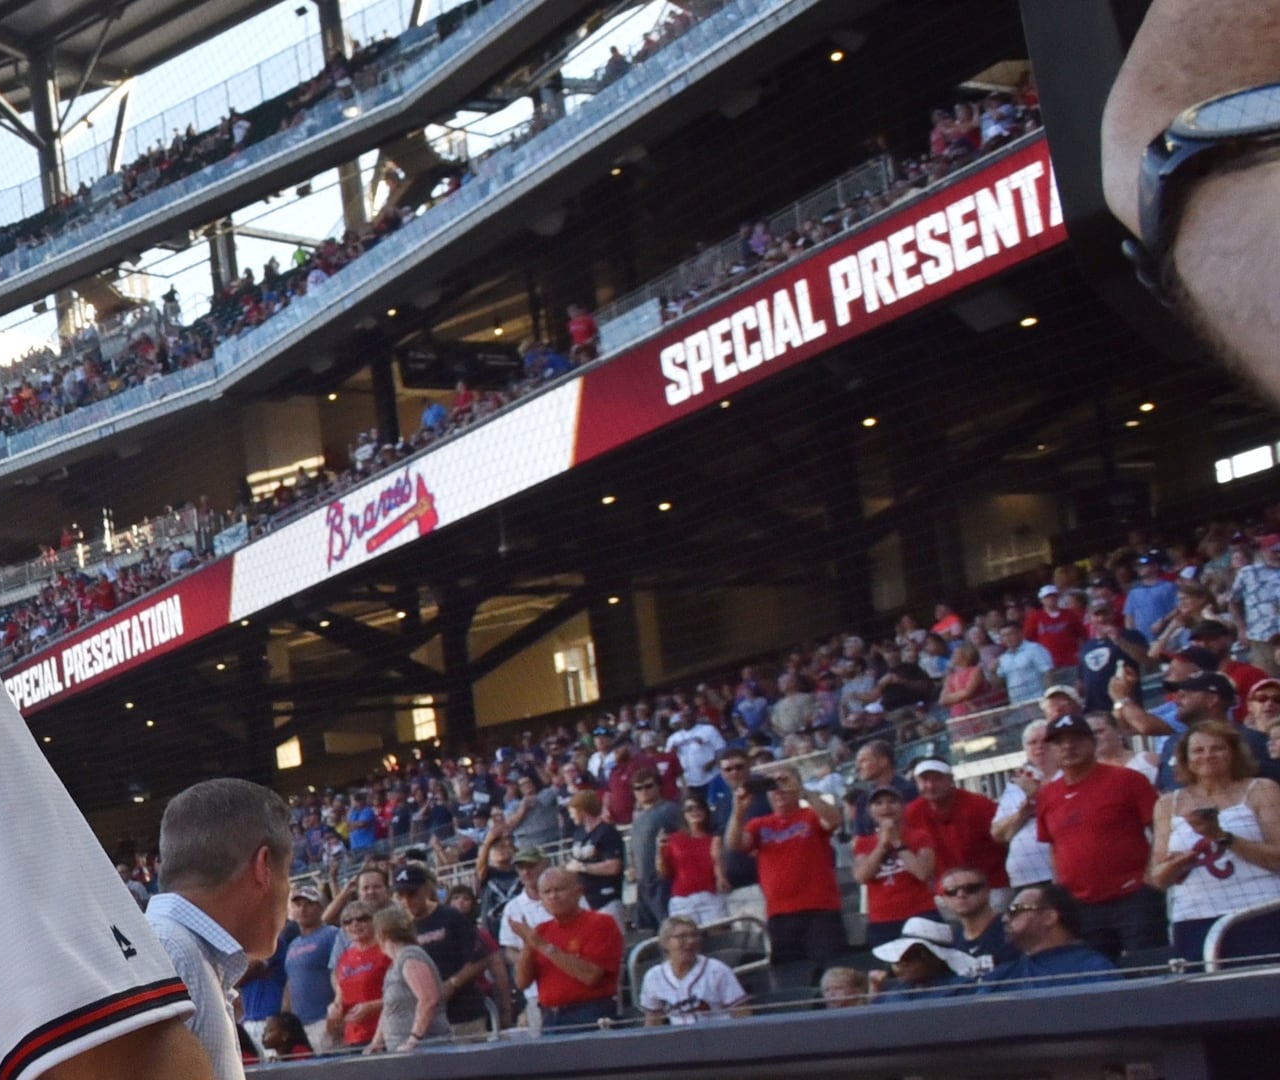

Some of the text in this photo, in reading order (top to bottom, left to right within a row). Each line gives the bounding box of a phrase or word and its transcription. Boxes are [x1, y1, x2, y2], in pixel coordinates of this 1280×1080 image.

[660, 278, 827, 407] SPECIAL
[326, 466, 412, 572] Braves
[4, 594, 184, 711] SPECIAL PRESENTATION
